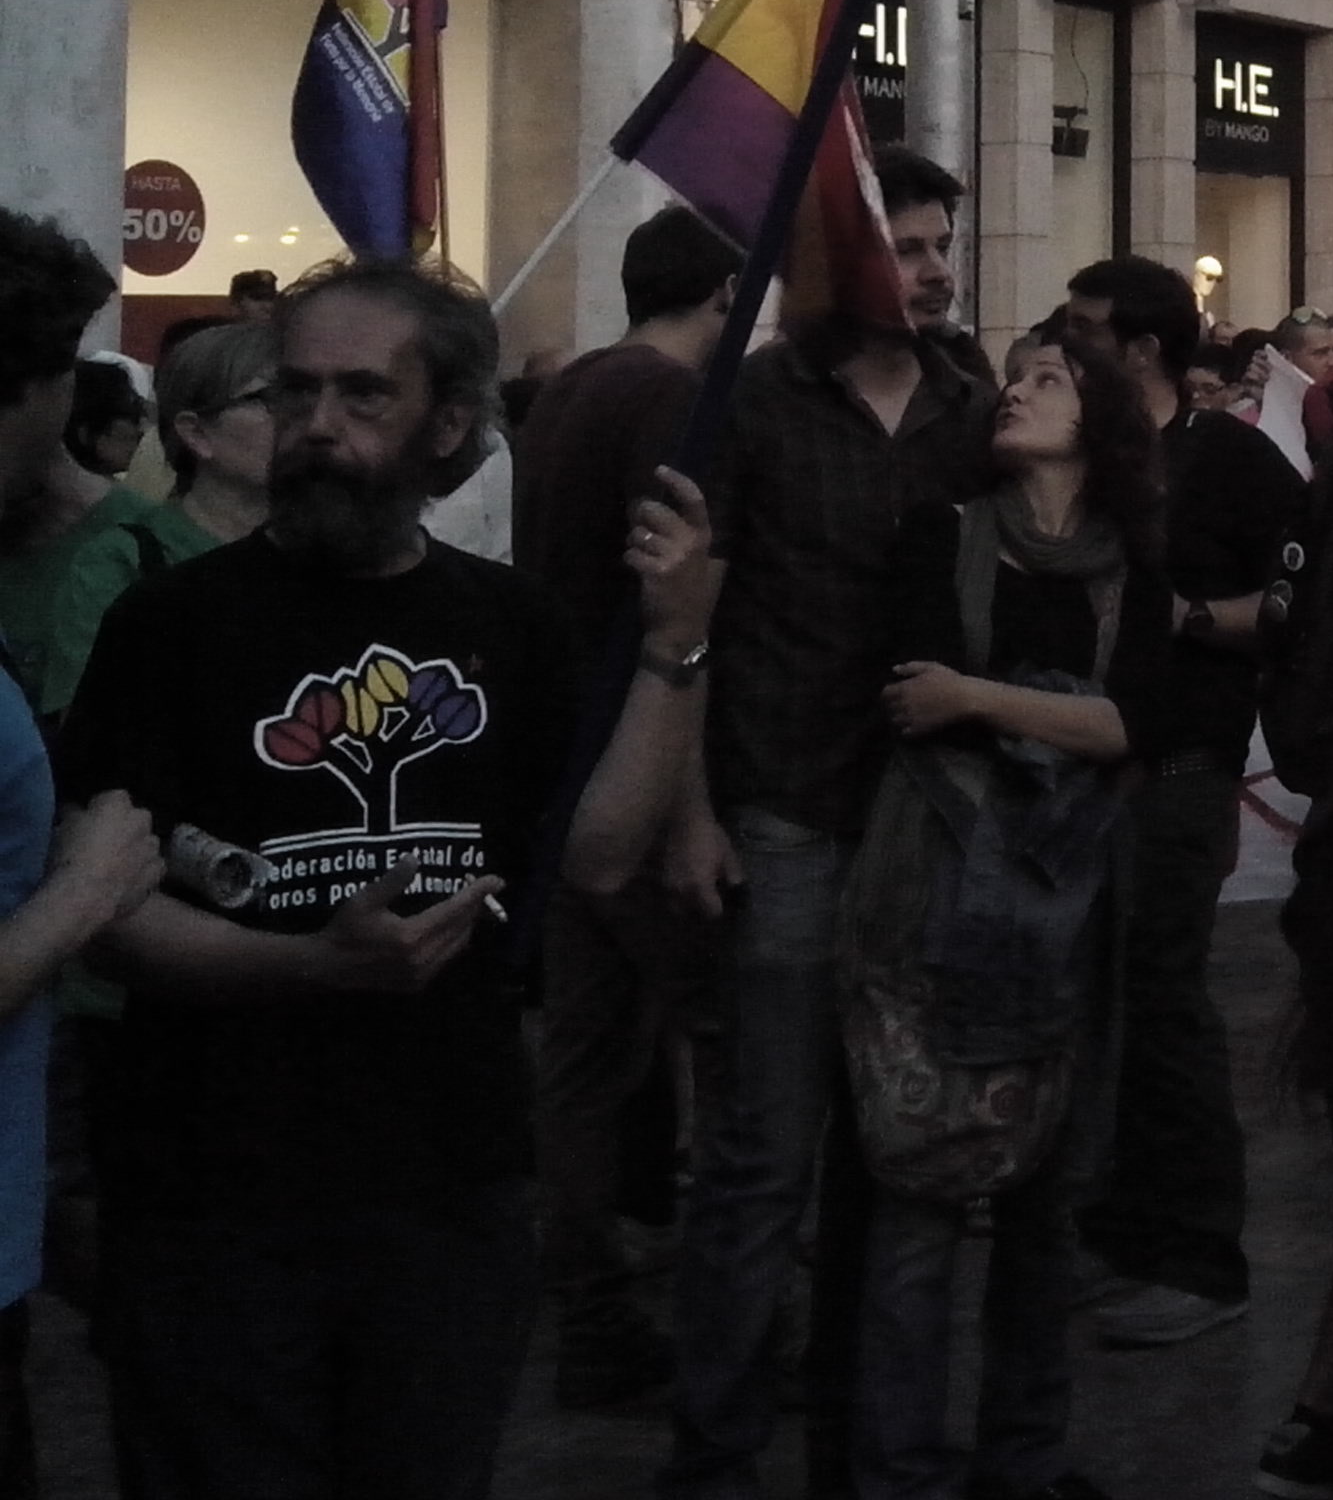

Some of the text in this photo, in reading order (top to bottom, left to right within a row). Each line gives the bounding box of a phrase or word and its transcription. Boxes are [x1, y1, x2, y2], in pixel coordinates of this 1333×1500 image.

[1215, 58, 1280, 118] H.E.
[1205, 120, 1270, 142] BY MANGO
[131, 176, 182, 191] HASTA
[122, 208, 202, 243] 50%
[264, 848, 377, 885] ederación
[460, 845, 485, 868] de
[264, 886, 318, 911] oros
